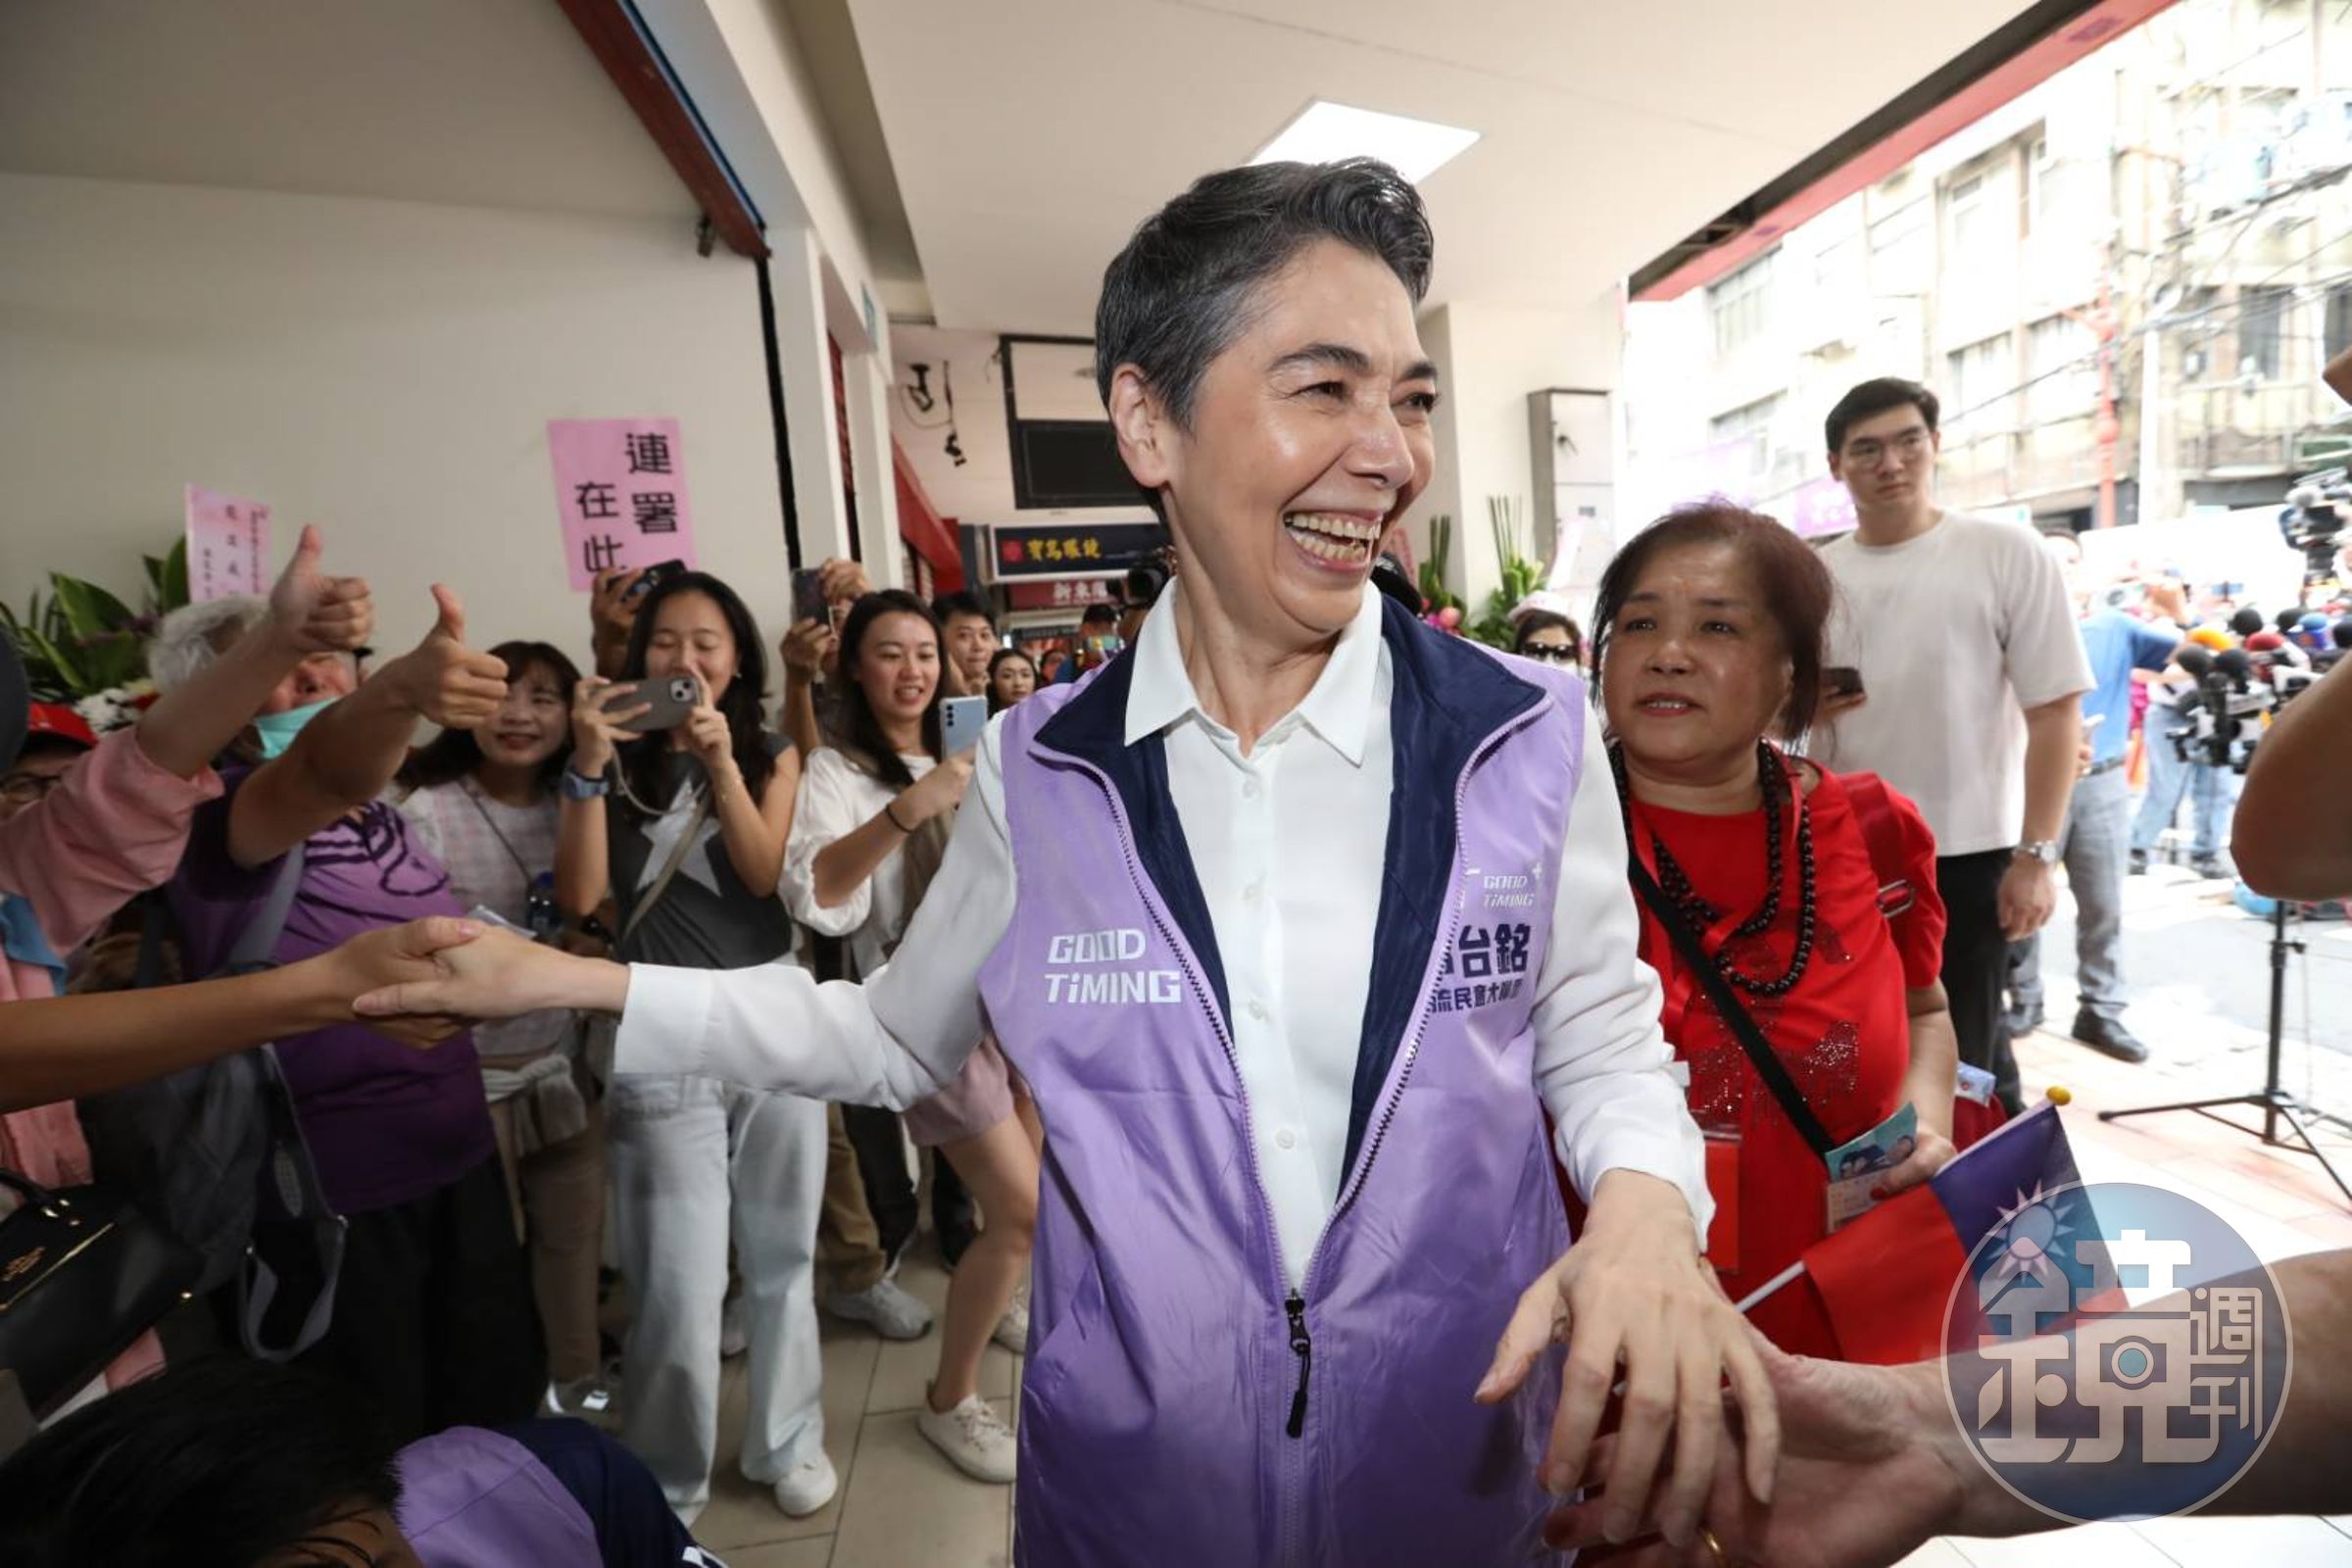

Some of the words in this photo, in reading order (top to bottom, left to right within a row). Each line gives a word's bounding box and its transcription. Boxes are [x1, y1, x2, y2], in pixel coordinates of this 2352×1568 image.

[625, 432, 677, 534] 連署
[574, 481, 624, 572] 在此
[1484, 875, 1529, 890] GOOD
[1047, 929, 1147, 964] GOOD
[1444, 923, 1531, 978] 台銘
